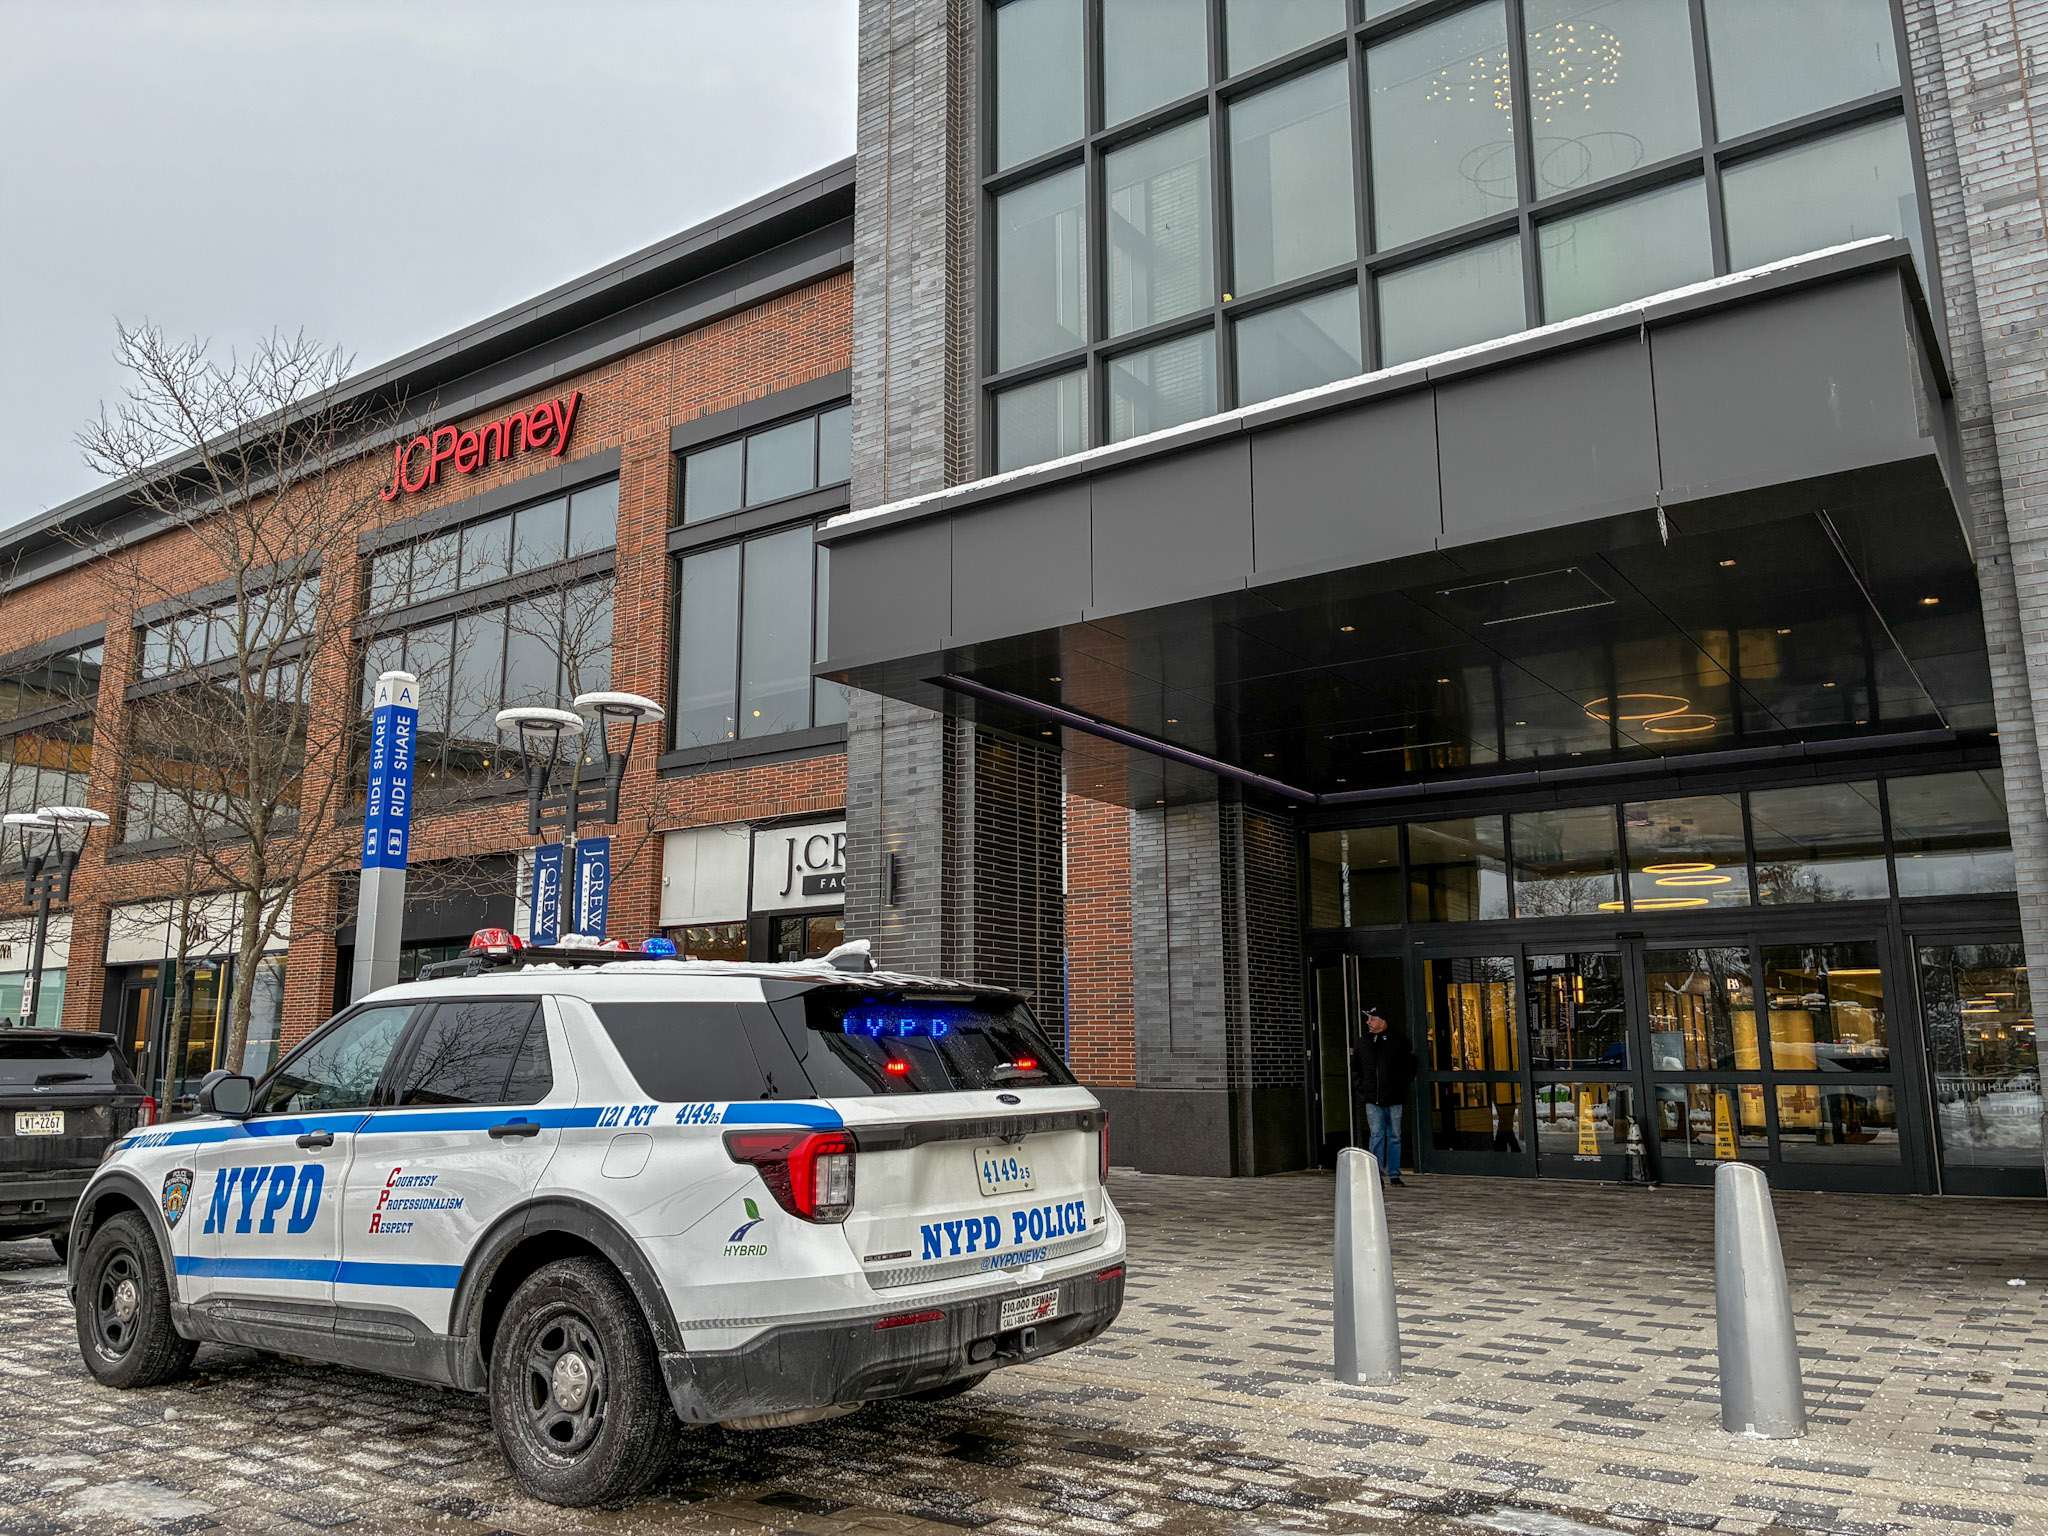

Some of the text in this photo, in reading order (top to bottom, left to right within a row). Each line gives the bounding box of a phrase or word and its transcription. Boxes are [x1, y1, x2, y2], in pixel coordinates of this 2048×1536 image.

[380, 391, 582, 501] JCPenney
[379, 686, 388, 701] A
[400, 687, 412, 703] A
[370, 714, 387, 816] RIDE SHARE
[390, 714, 411, 817] RIDE SHARE
[624, 1105, 658, 1126] PCT
[136, 1132, 174, 1149] POLICE
[386, 1167, 438, 1187] COURTESY
[203, 1164, 324, 1234] NYPD
[376, 1190, 464, 1210] PROFESSIONALISM
[368, 1213, 413, 1233] RESPECT
[920, 1200, 1086, 1260] NYPD POLICE
[723, 1244, 768, 1257] HYBRID
[980, 1246, 1047, 1271] @NYPDNEWS
[1003, 1298, 1030, 1315] $10,000
[1032, 1292, 1058, 1307] REWARD
